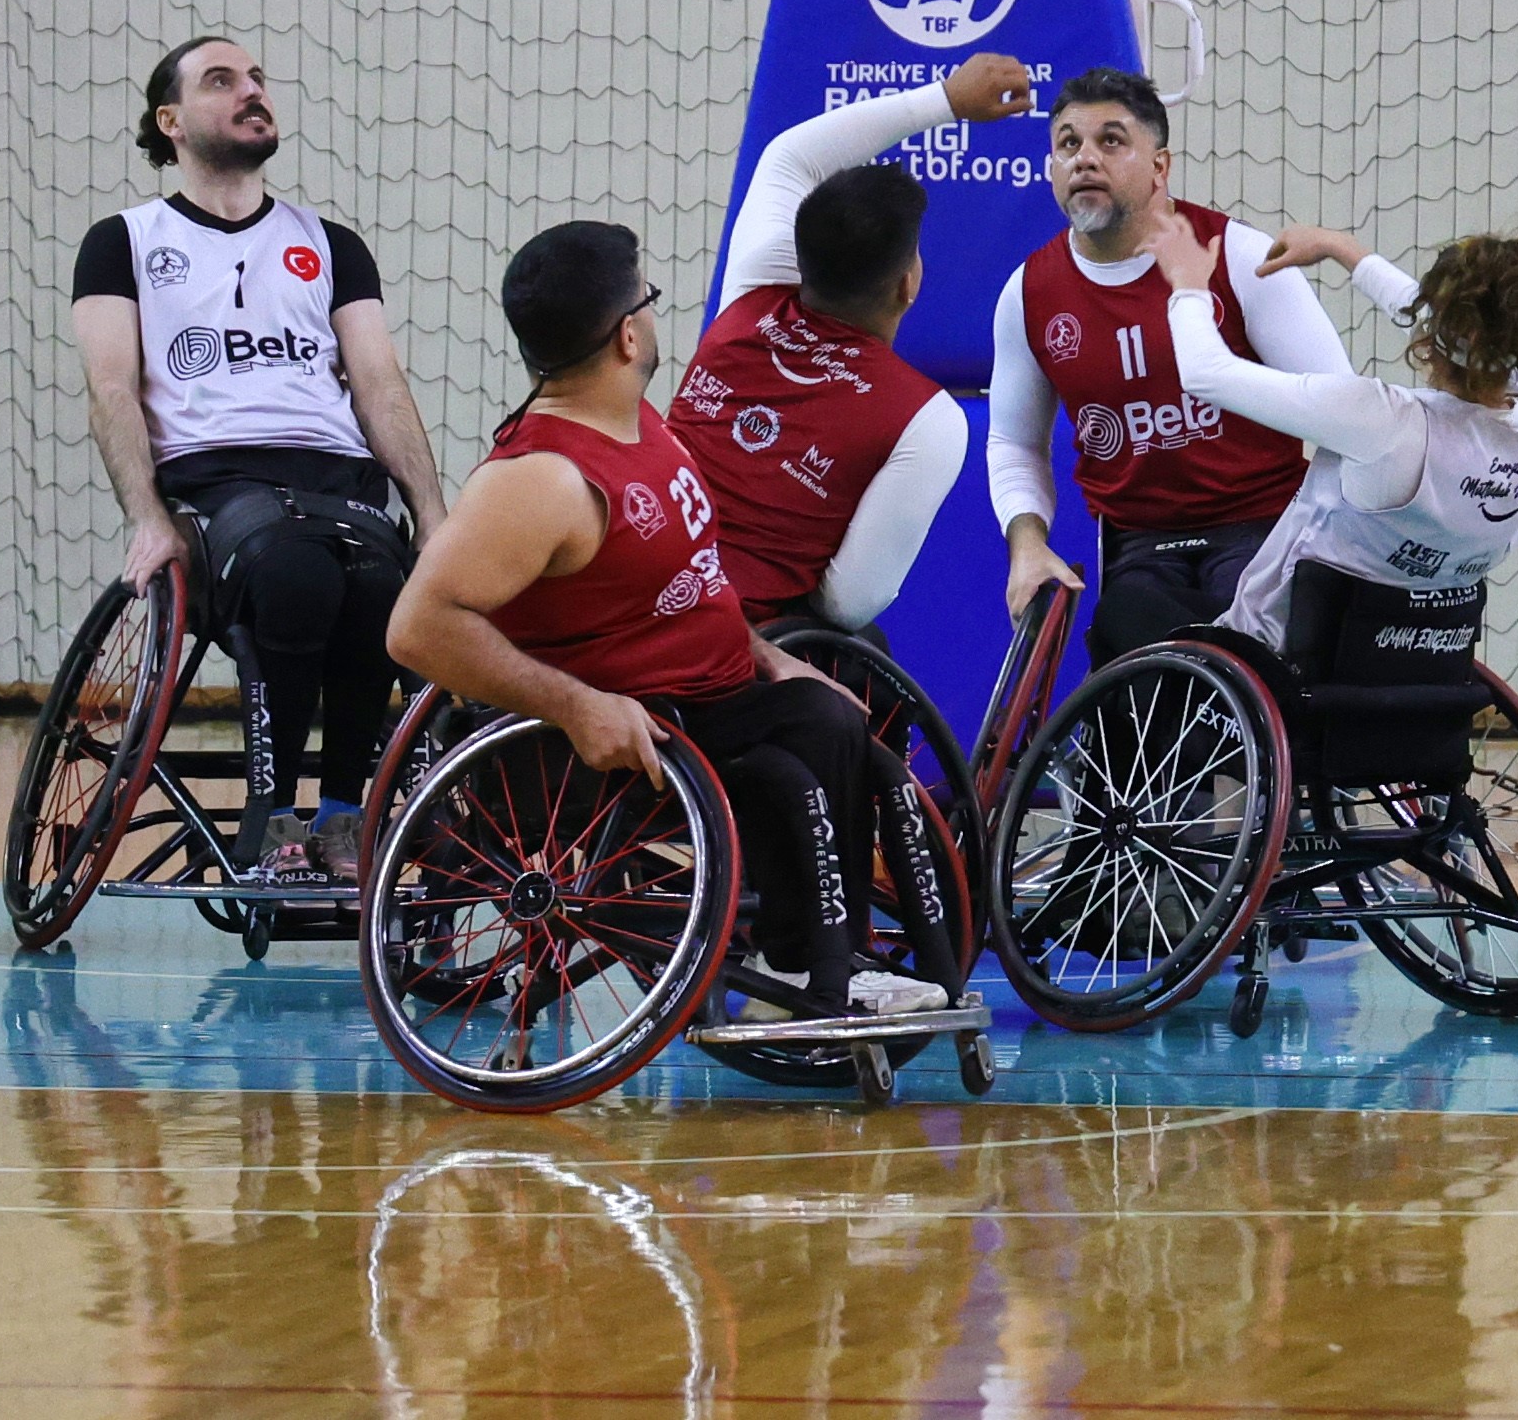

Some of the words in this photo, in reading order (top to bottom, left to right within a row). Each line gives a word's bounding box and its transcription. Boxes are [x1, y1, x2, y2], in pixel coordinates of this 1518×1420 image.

[921, 16, 959, 33] TBF
[826, 60, 926, 82] TÜRKİYE
[931, 63, 1052, 82] KAAR
[224, 327, 319, 364] Beta
[1116, 325, 1147, 380] 11
[1124, 393, 1221, 442] Beta
[669, 467, 712, 541] 23
[1155, 538, 1209, 551] EXTRA
[1195, 703, 1241, 743] EXTR
[804, 789, 819, 817] THE
[1280, 834, 1342, 852] XTRA
